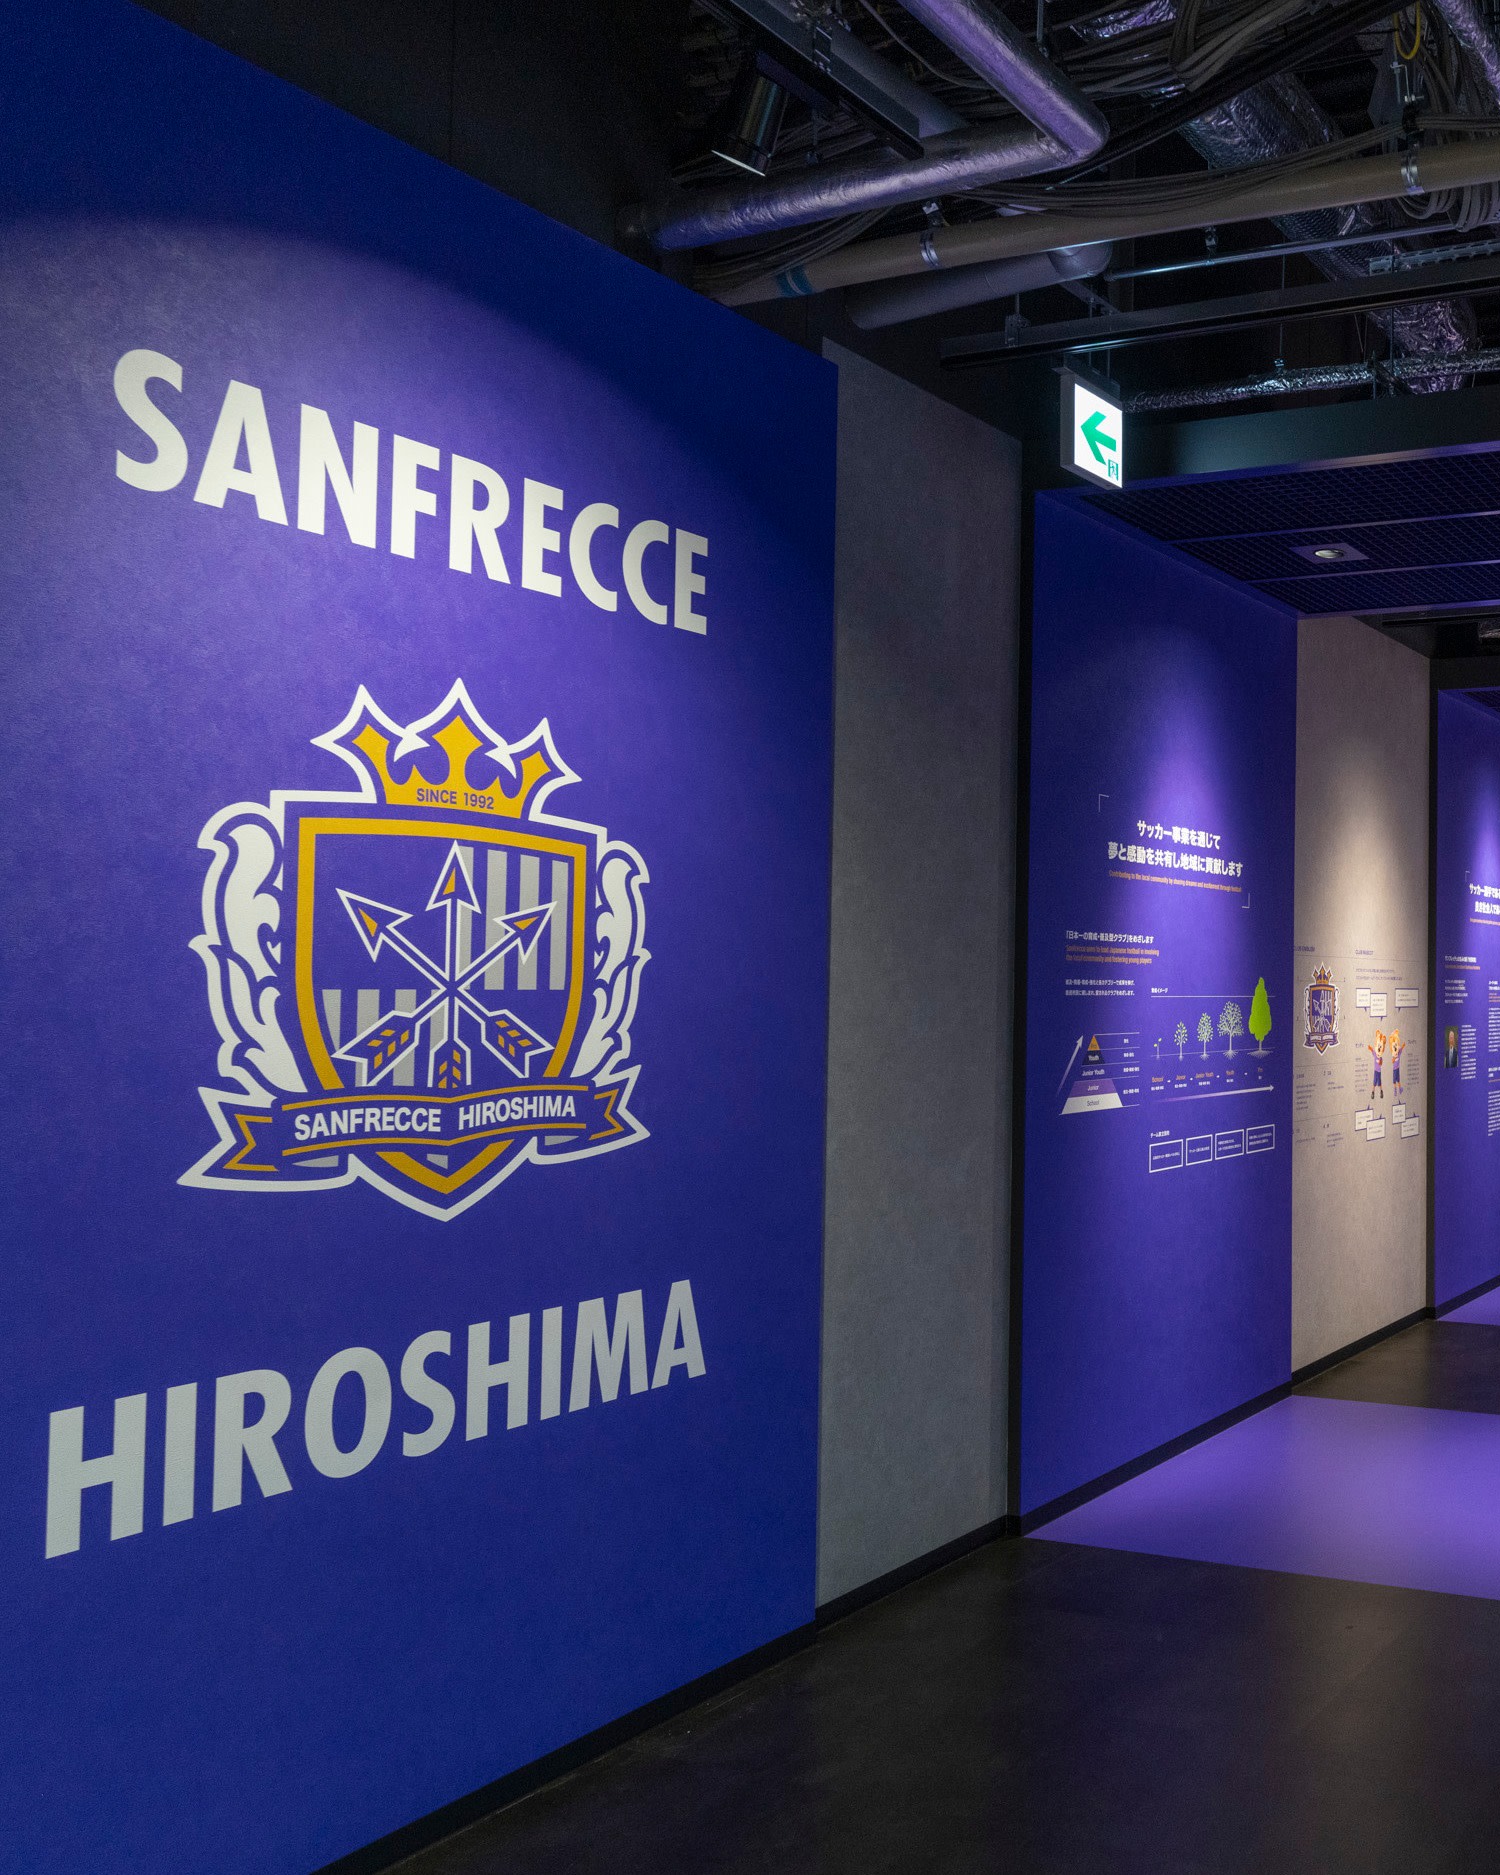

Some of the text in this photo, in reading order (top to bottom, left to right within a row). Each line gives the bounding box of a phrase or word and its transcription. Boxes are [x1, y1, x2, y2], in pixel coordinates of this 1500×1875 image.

[114, 349, 708, 635] SANFRECCE
[417, 788, 494, 809] SINCE 1992
[1137, 820, 1221, 849] サッカー事業を通じて
[1108, 841, 1243, 877] 夢と感動を共有し地域に貢献します
[294, 1096, 576, 1141] SANFRECCE HIROSHIMA
[45, 1279, 706, 1559] HIROSHIMA
